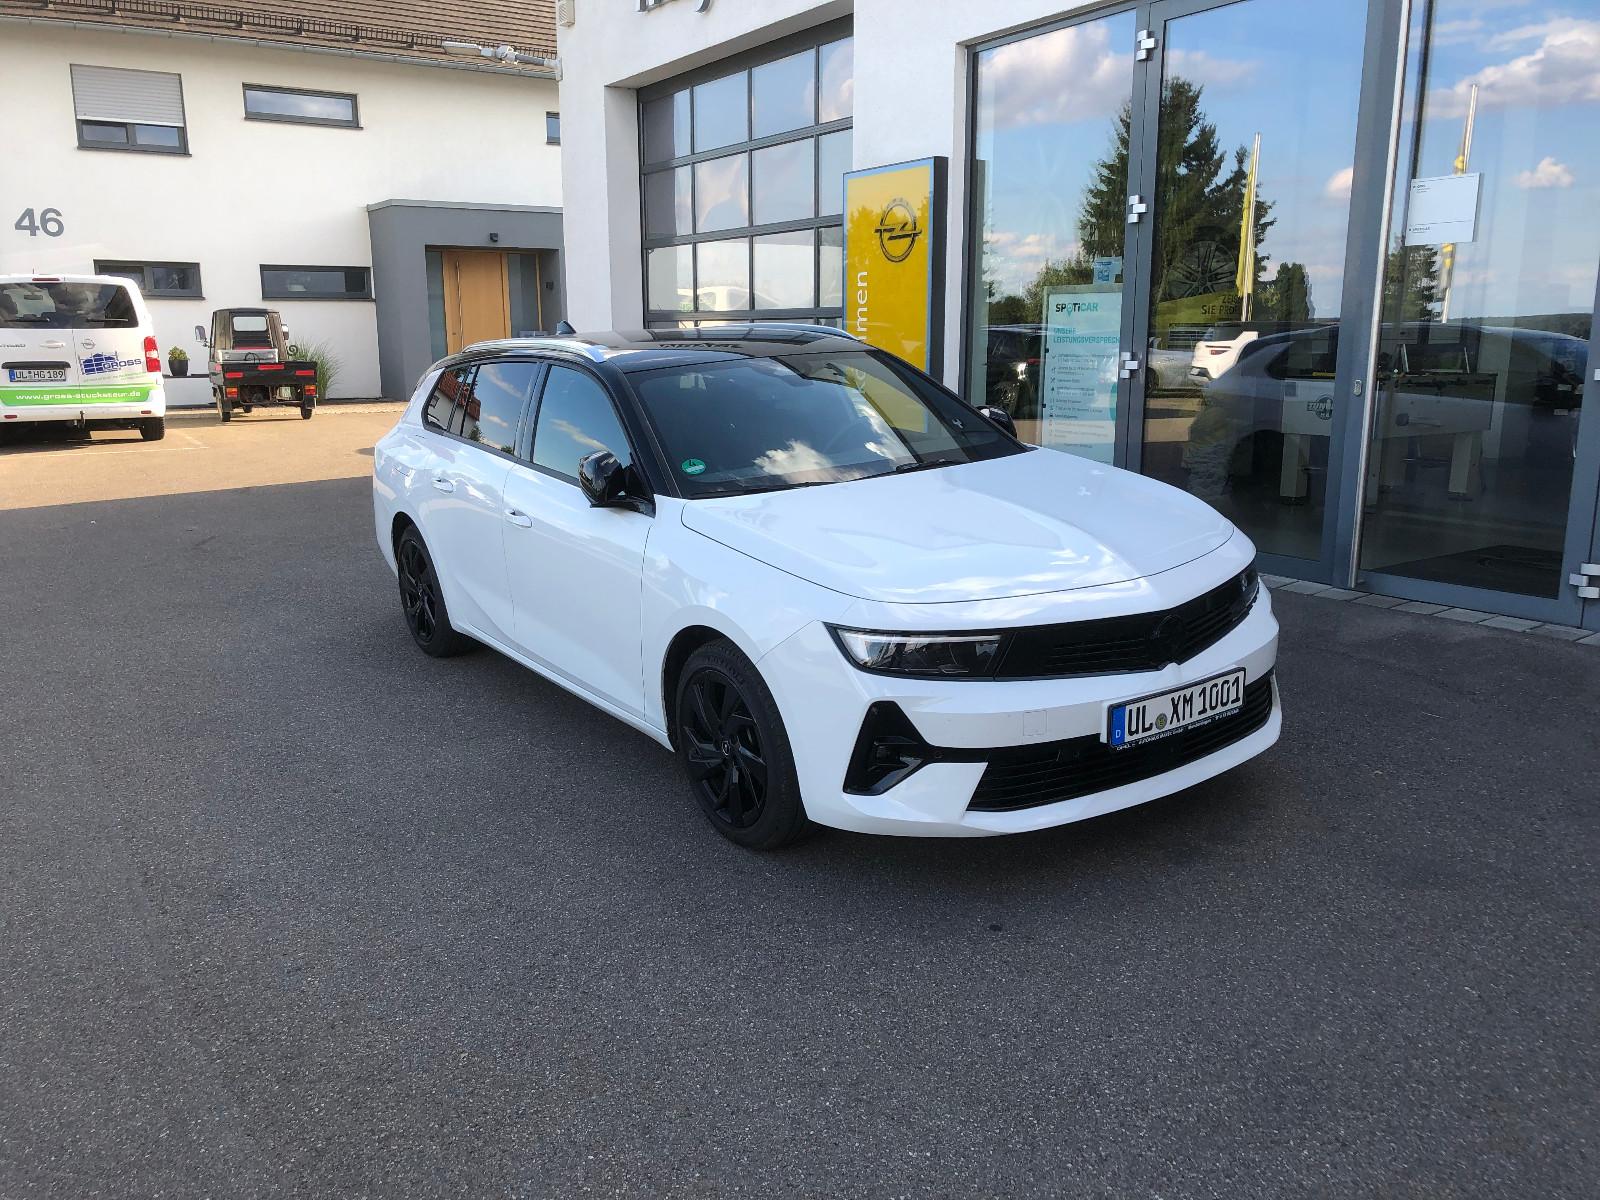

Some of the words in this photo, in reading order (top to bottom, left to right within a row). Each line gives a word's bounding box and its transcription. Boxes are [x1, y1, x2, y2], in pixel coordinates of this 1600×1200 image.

[14, 207, 65, 237] 46
[1201, 305, 1216, 315] SIE
[102, 358, 142, 371] GROSS
[47, 370, 63, 379] 189
[1128, 705, 1153, 736] UL
[1170, 692, 1194, 725] XM
[1197, 676, 1241, 715] 1001
[1115, 729, 1121, 739] D
